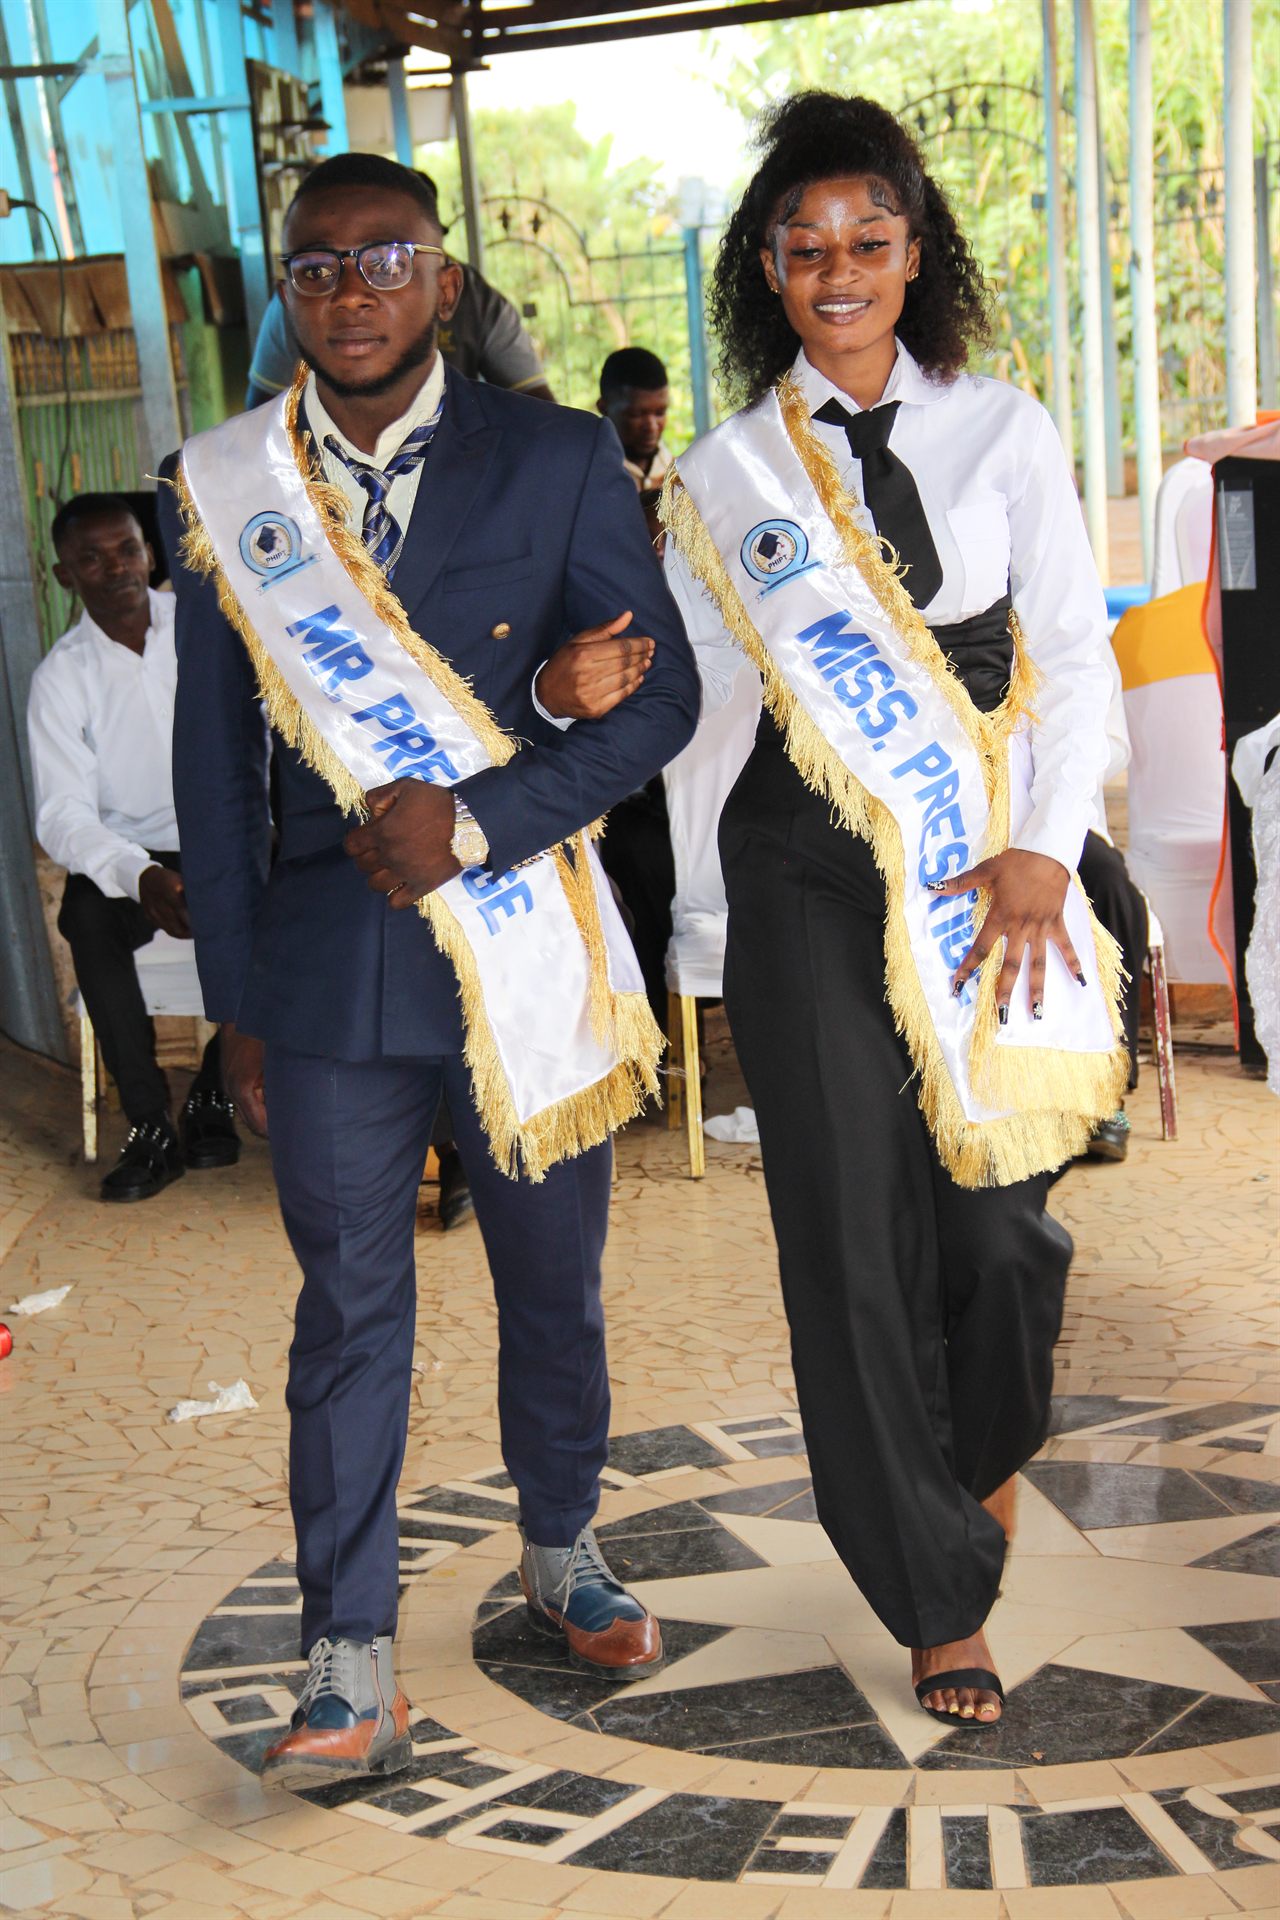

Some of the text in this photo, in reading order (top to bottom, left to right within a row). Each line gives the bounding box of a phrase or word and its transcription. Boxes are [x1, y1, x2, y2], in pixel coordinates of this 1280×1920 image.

[265, 550, 287, 564] PHIPT
[767, 554, 788, 569] PHIPT
[795, 608, 919, 752] MISS.
[285, 604, 534, 937] MR. PREGE
